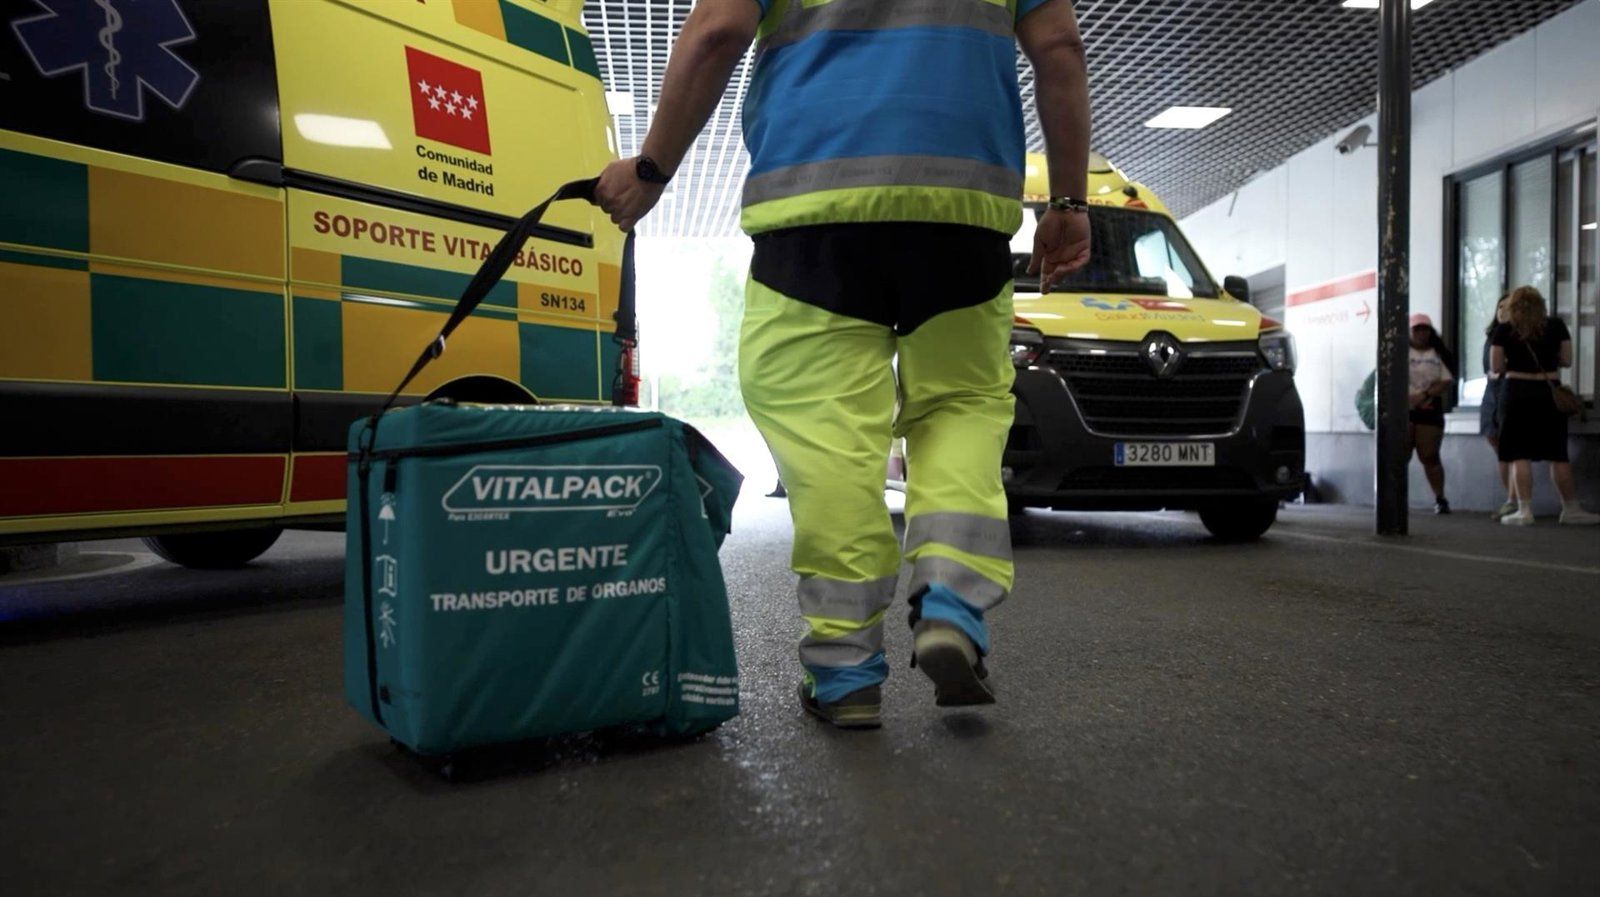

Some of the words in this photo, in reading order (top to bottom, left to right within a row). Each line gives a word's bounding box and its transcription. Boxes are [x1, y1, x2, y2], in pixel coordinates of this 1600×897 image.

[416, 144, 494, 176] Comunidad
[418, 166, 439, 182] de
[442, 170, 495, 197] Madrid
[313, 210, 436, 253] SOPORTE
[443, 235, 494, 262] VITA
[513, 246, 584, 277] BÁSICO
[540, 292, 586, 312] SN134
[1128, 444, 1172, 462] 3280
[1178, 444, 1210, 462] MNT
[472, 475, 645, 501] VITALPACK
[485, 544, 629, 575] URGENTE
[430, 587, 559, 612] TRANSPORTE
[566, 586, 587, 603] DE
[592, 577, 666, 599] ORGANOS
